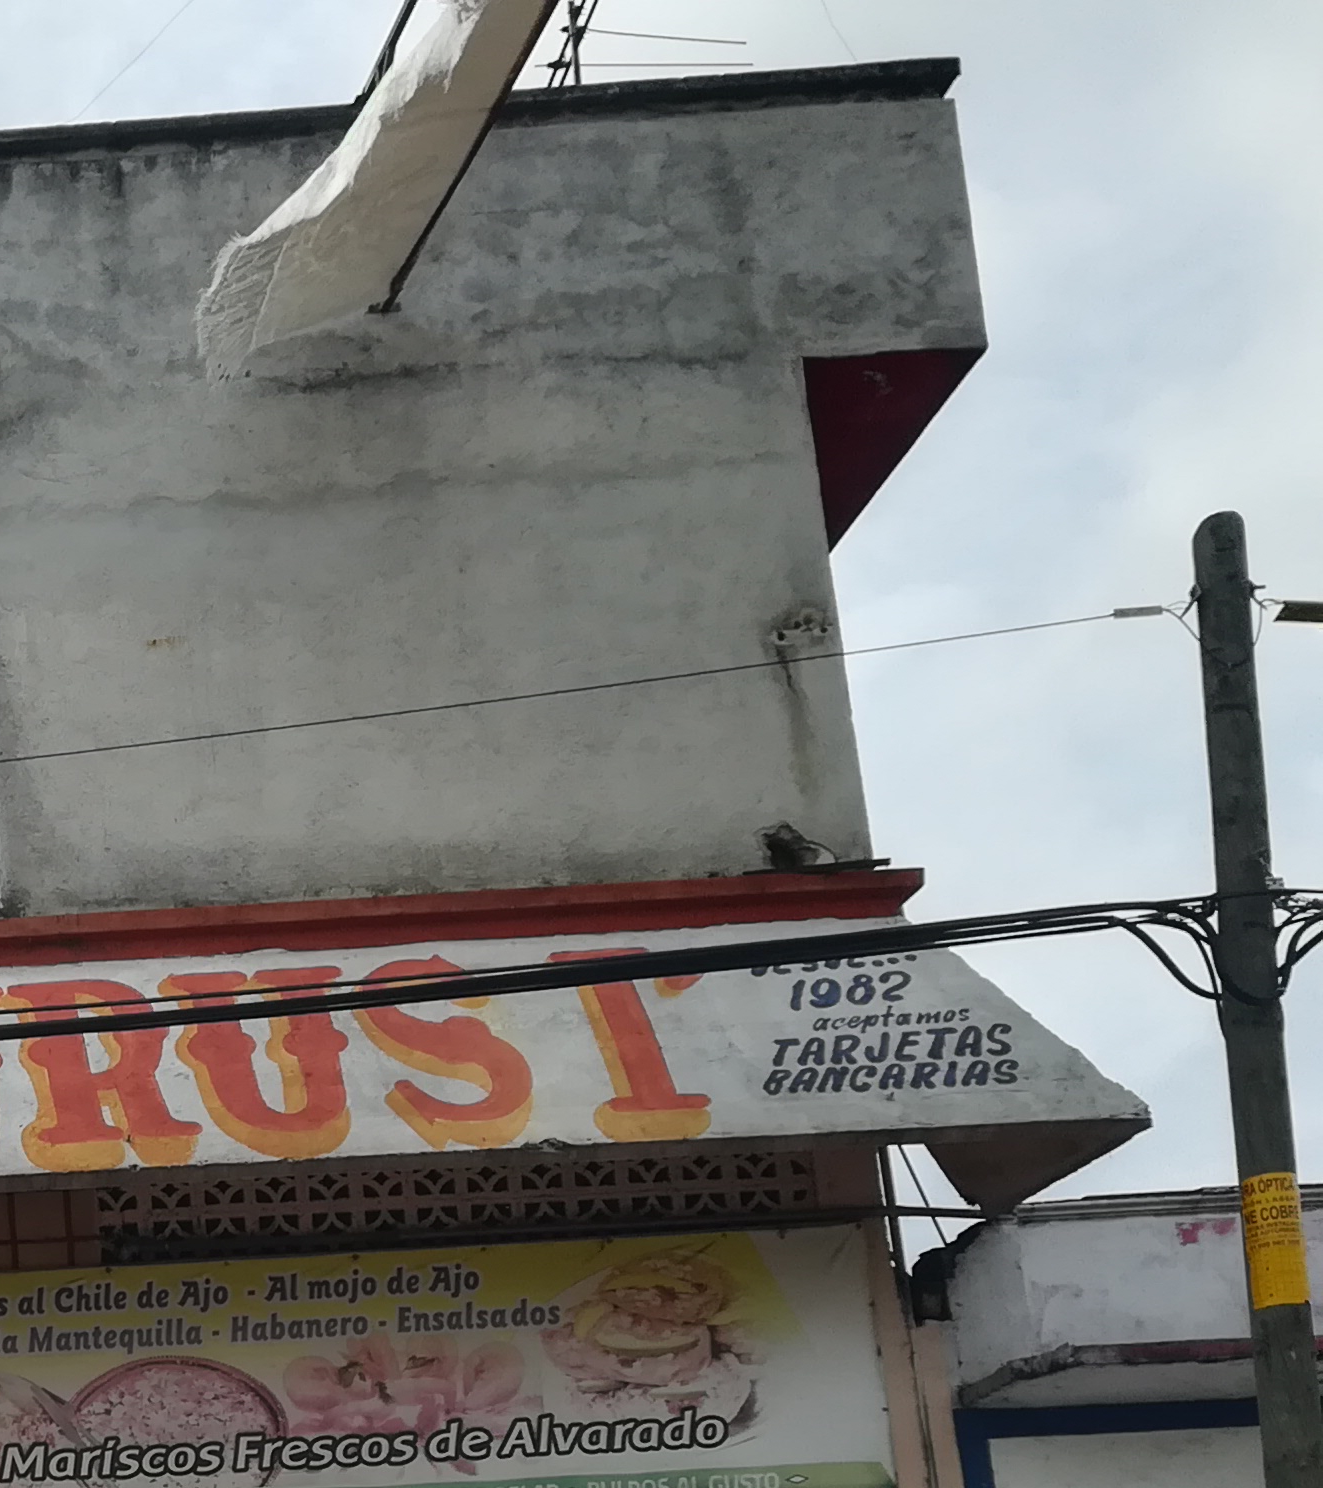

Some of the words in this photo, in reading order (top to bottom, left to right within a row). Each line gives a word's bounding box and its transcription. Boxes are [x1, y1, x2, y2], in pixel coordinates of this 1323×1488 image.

[789, 970, 912, 1011] 1982
[812, 1005, 970, 1034] aceptamos
[771, 1022, 1013, 1068] TARJETAS
[761, 1058, 1020, 1097] BANCARIAS
[16, 1287, 45, 1315] al
[54, 1281, 128, 1315] Chile
[143, 1281, 174, 1310] de
[178, 1276, 231, 1316] Ajo
[263, 1271, 299, 1303] Al
[306, 1271, 380, 1308] mojo
[386, 1267, 422, 1297] de
[427, 1263, 481, 1300] Ajo
[27, 1316, 205, 1360] Mantequilla
[231, 1307, 370, 1346] Habanero
[396, 1298, 563, 1337] Ensalsados
[233, 1428, 419, 1474] Frescos
[426, 1418, 495, 1464] de
[496, 1406, 732, 1460] Alvarado
